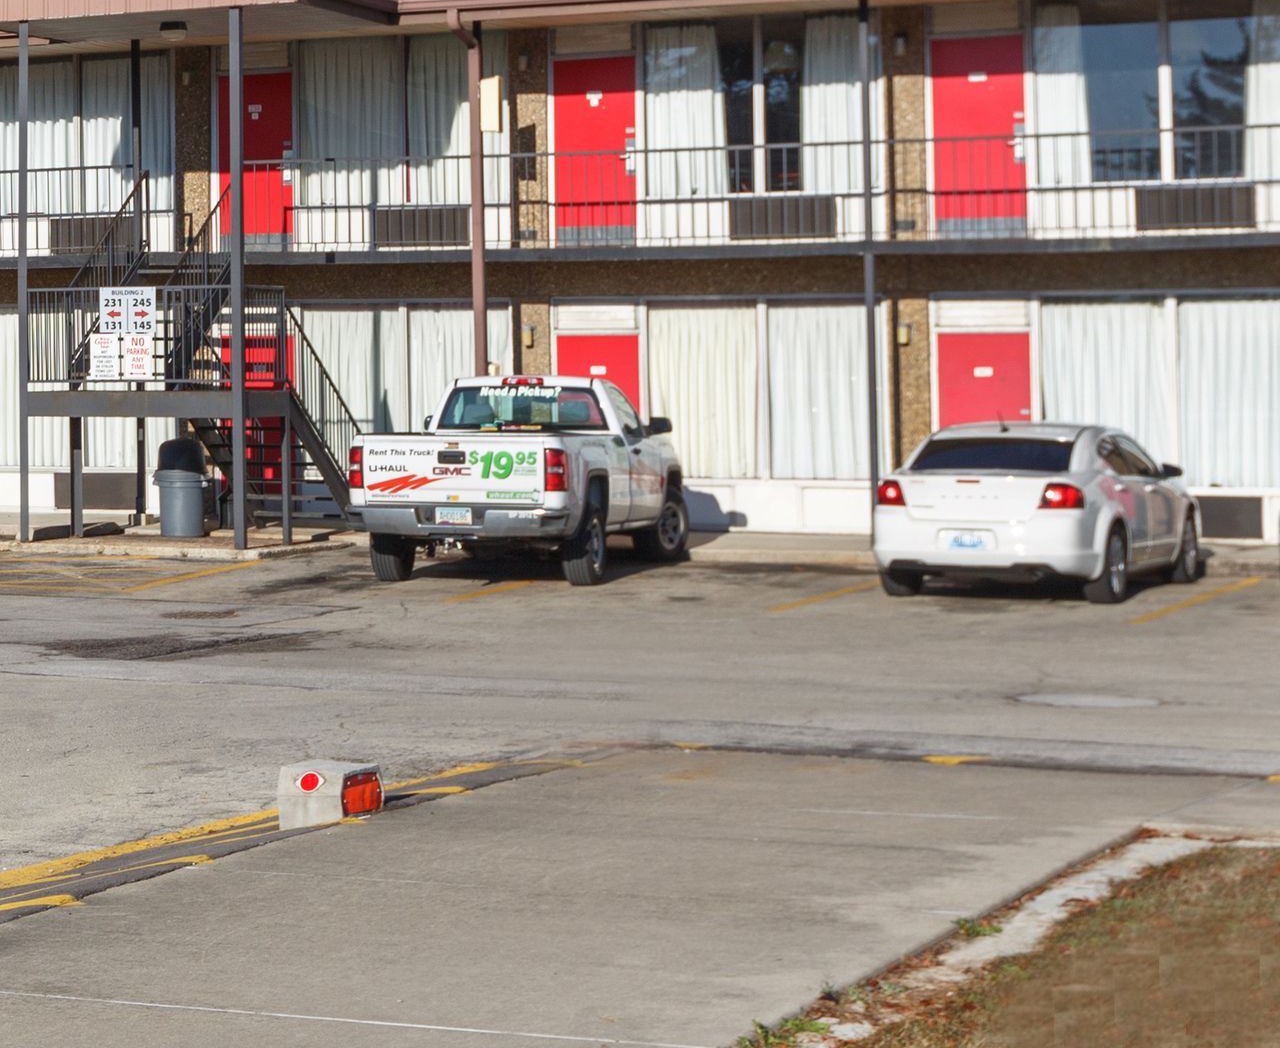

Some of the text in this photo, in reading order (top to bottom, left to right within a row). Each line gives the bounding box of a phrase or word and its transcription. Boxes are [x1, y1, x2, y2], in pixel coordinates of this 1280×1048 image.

[104, 298, 122, 307] 231
[132, 298, 152, 307] 245
[105, 321, 122, 330] 131
[133, 321, 152, 330] 145
[131, 337, 145, 346] NO
[480, 386, 561, 398] Need a Pickup?
[432, 467, 472, 475] GMC
